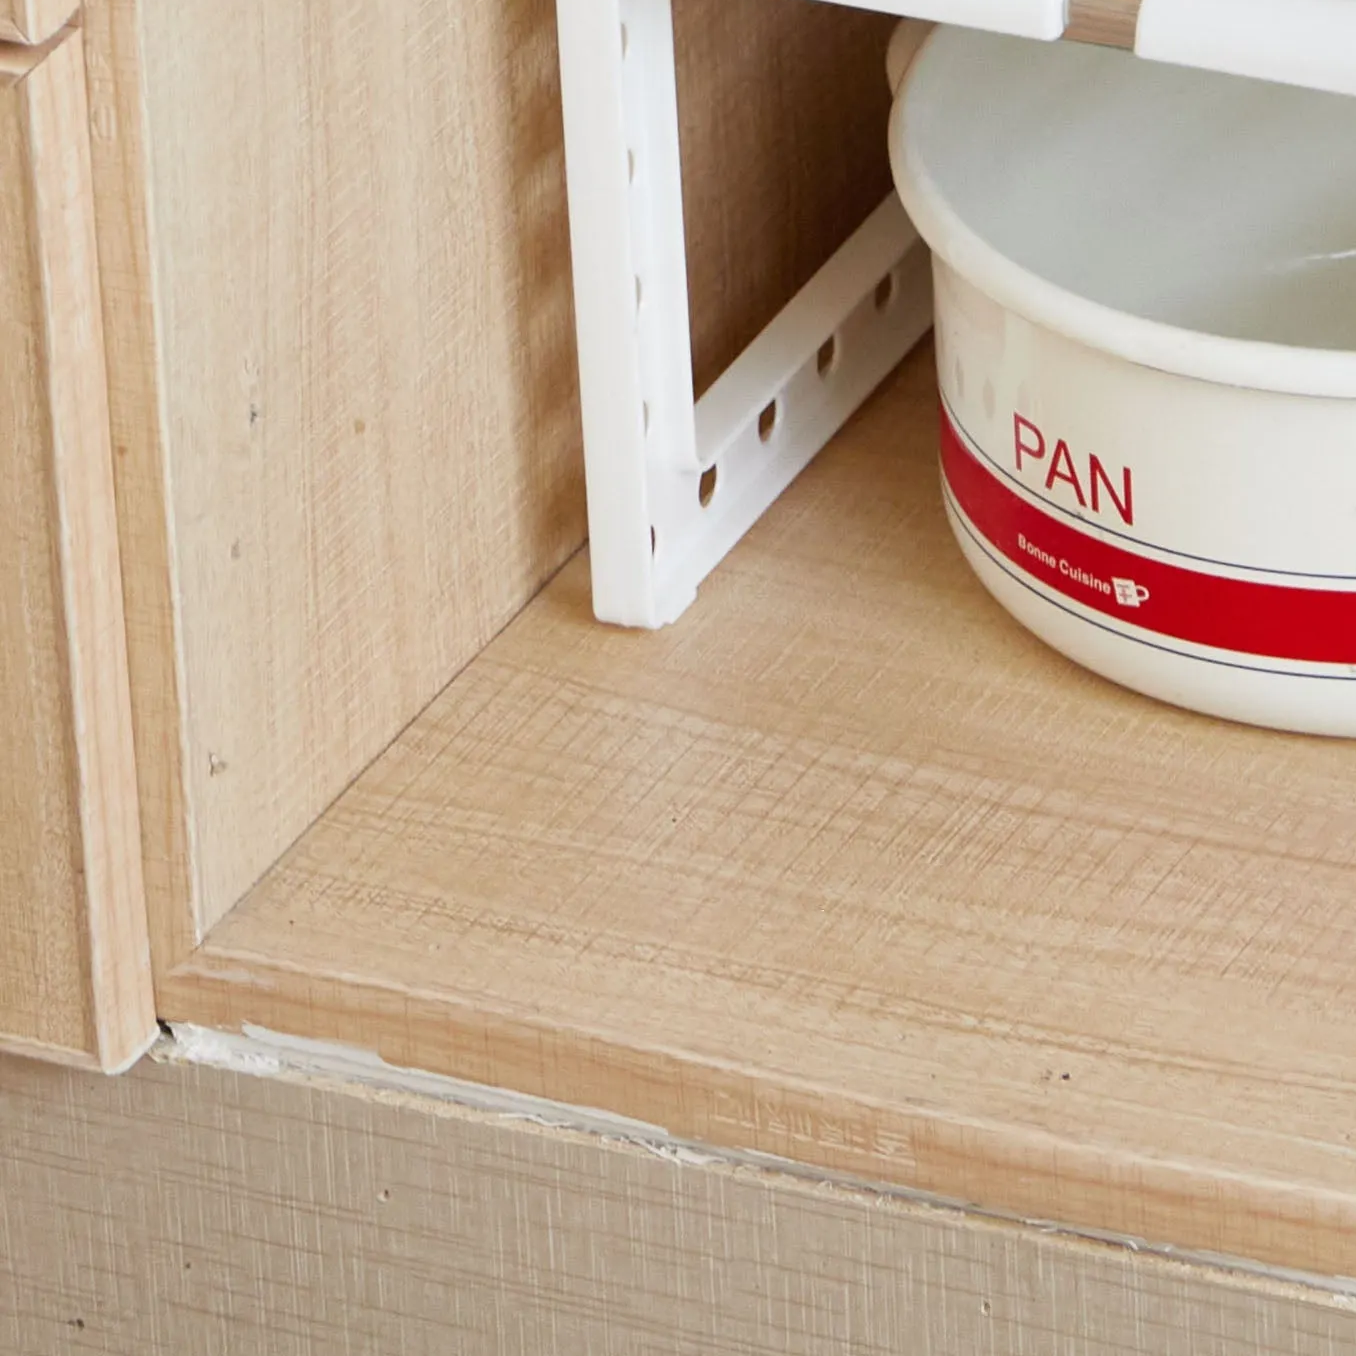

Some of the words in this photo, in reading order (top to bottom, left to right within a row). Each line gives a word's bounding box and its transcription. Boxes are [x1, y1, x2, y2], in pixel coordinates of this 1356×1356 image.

[1013, 412, 1133, 525] PAN
[1018, 533, 1056, 569] Bonne
[1059, 559, 1111, 594] Cuisine
